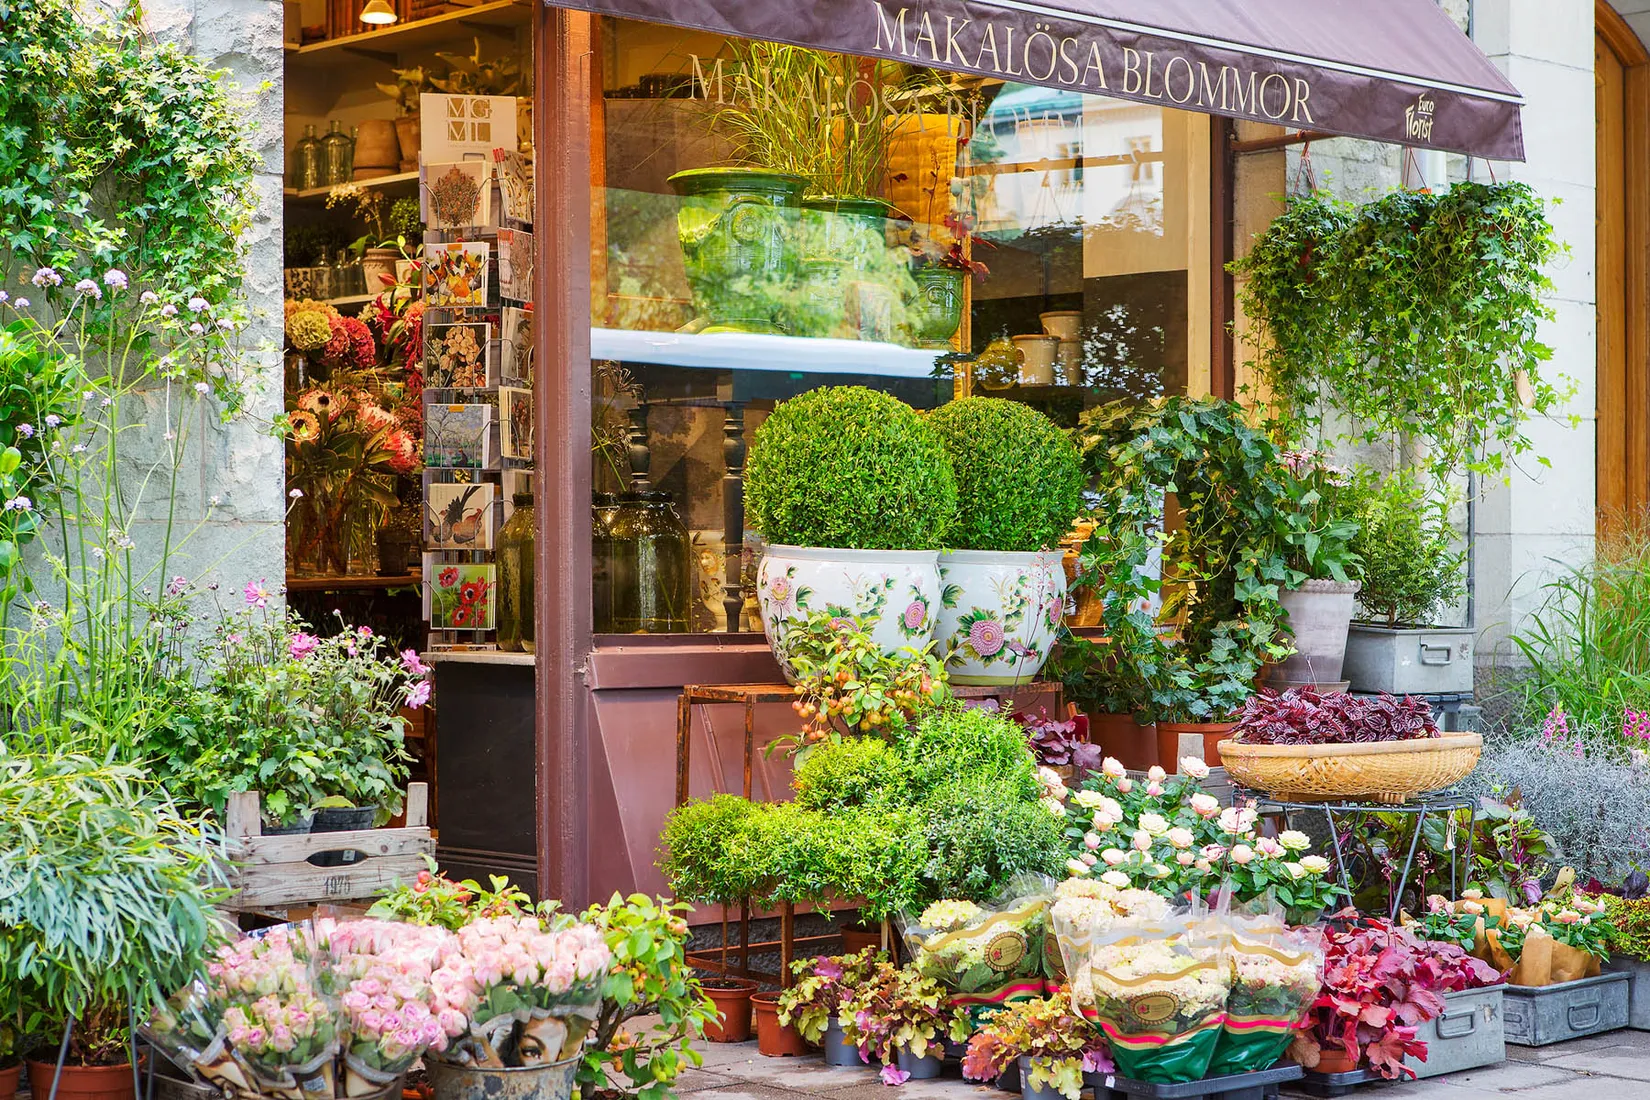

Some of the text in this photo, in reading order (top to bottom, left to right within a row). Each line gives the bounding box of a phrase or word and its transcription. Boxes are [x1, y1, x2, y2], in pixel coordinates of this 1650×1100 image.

[873, 0, 1315, 124] MAKALÖSA BLOMMOR
[1418, 93, 1434, 113] Euro
[1405, 104, 1434, 143] Florist
